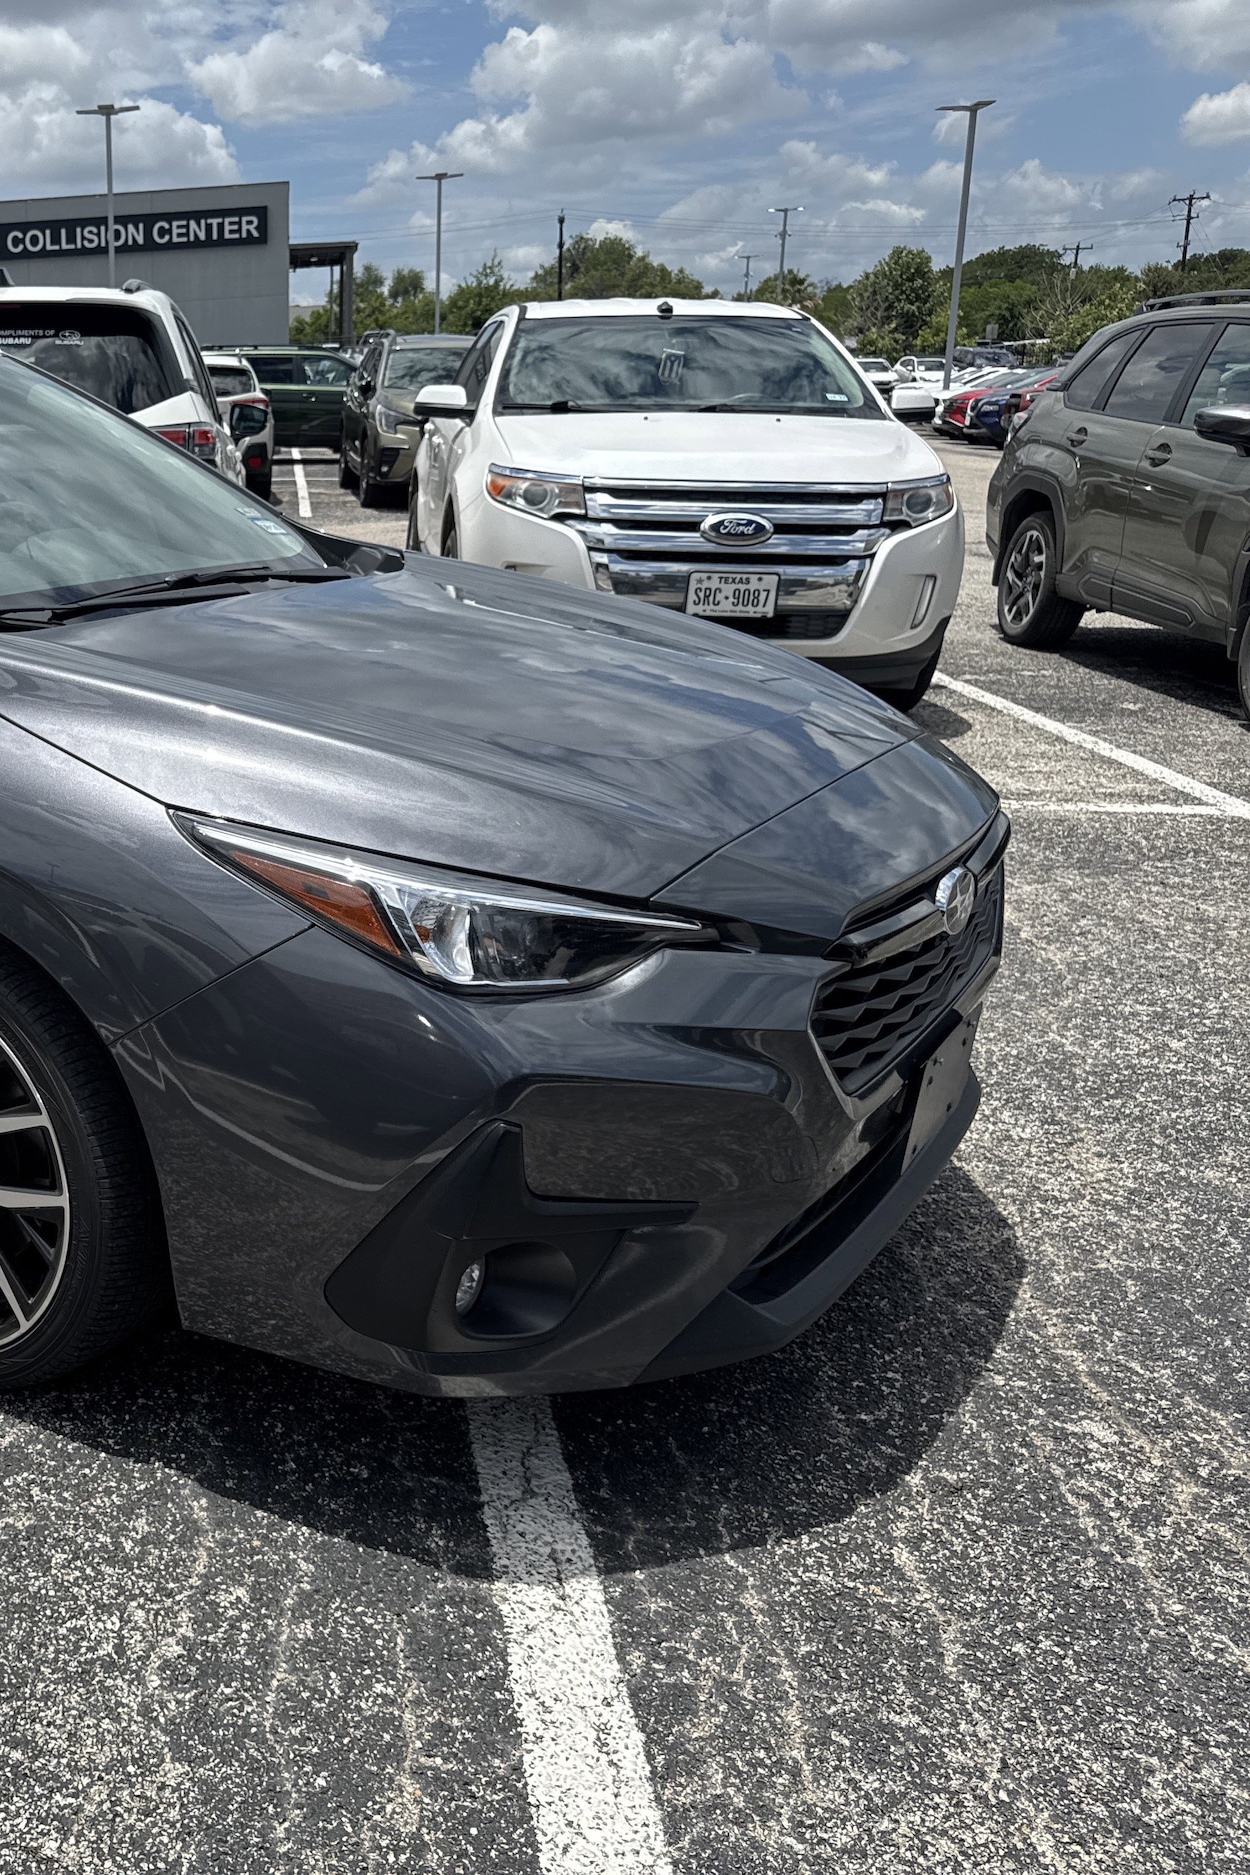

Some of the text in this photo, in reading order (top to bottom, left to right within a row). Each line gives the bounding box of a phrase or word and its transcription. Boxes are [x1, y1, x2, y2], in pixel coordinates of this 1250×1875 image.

[6, 221, 145, 254] COLLISION
[152, 215, 260, 245] CENTER
[720, 519, 756, 534] Ford
[718, 576, 751, 585] TEXAS
